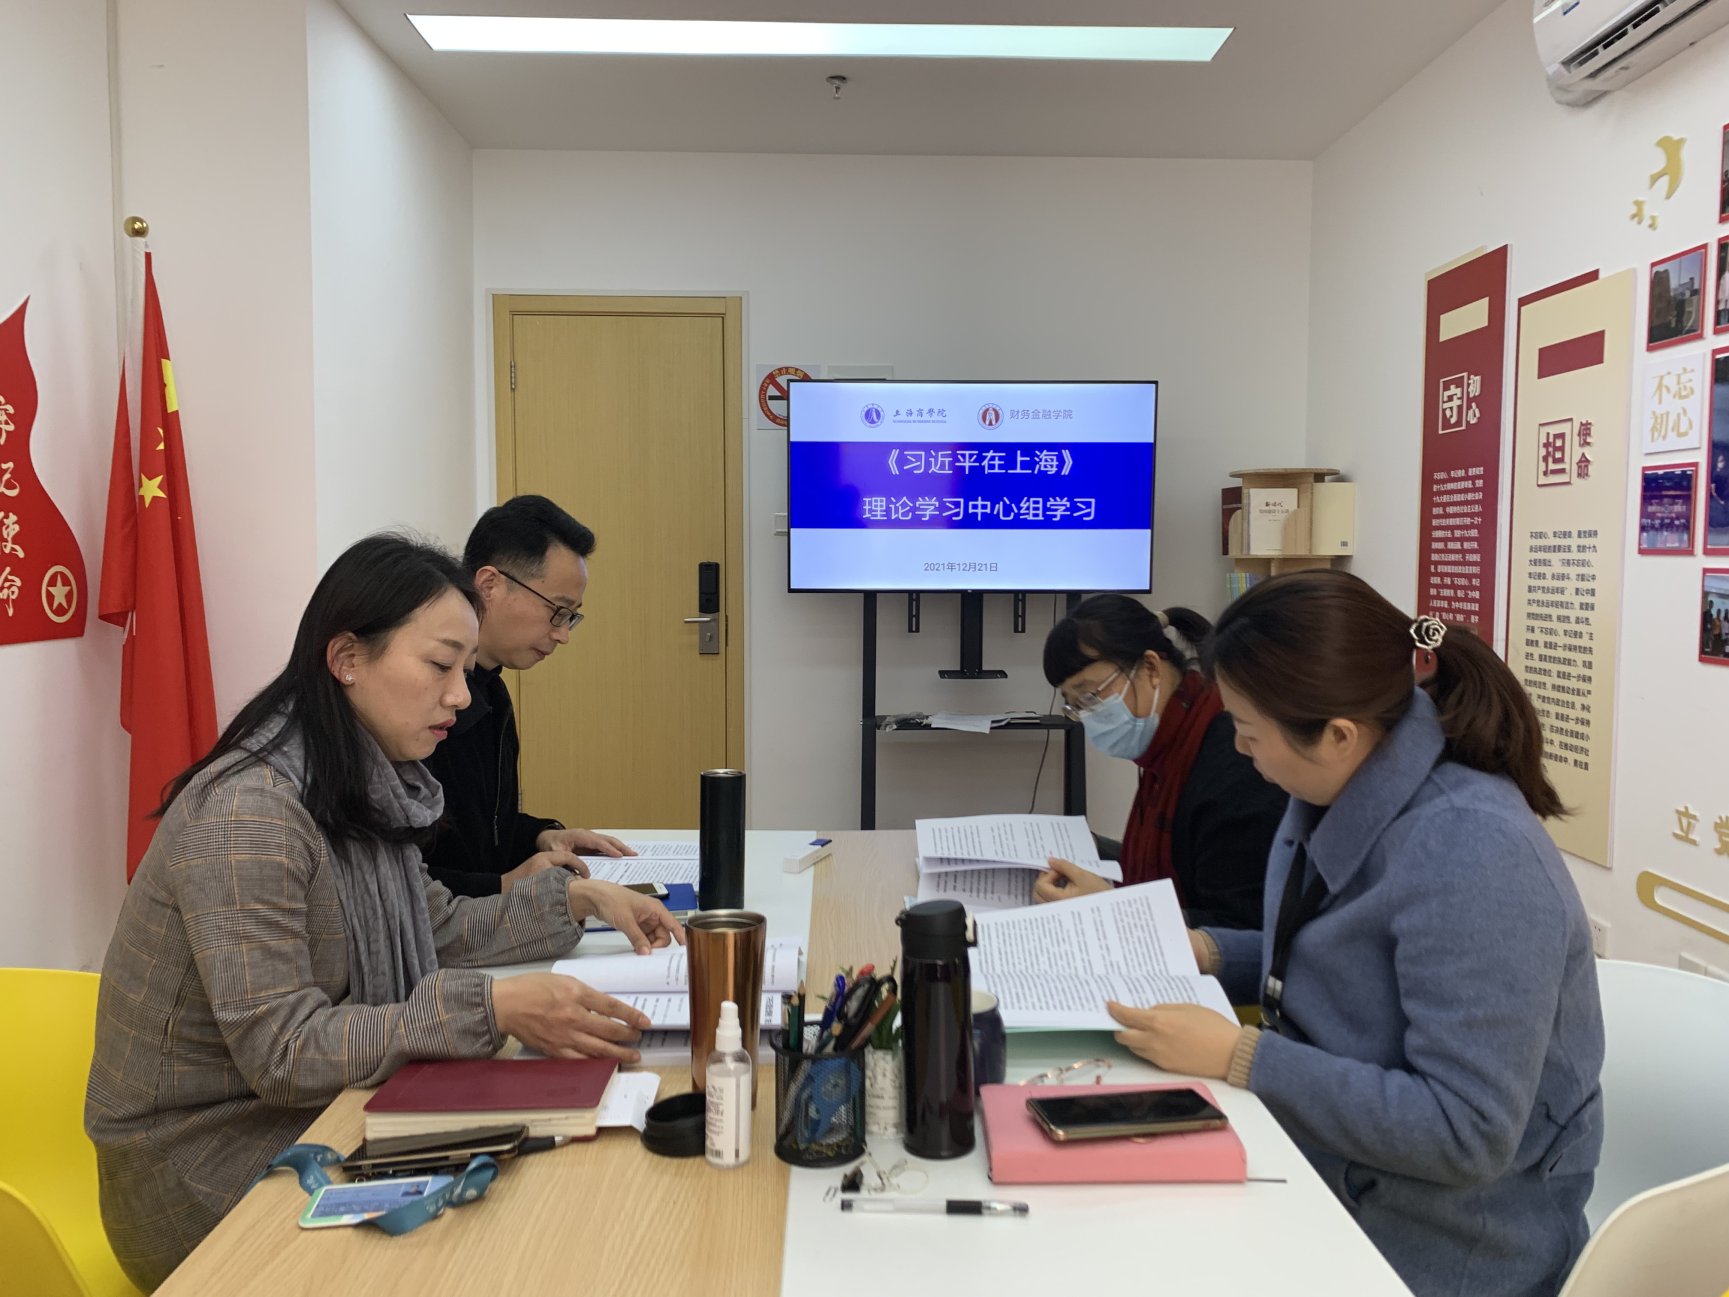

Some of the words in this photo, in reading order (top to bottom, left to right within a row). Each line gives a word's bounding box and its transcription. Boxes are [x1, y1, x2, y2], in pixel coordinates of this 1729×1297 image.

[1442, 383, 1463, 425] 守
[1467, 374, 1482, 425] 初心
[1651, 367, 1695, 405] 不忘
[1009, 408, 1073, 421] 财务金融学院
[1649, 407, 1694, 443] 初心
[887, 449, 1074, 475] 《习近平在上海》
[1542, 431, 1567, 478] 担
[1576, 420, 1593, 480] 使命
[862, 497, 1096, 521] 理论学习中心组学习
[923, 561, 998, 573] 2021年12月21日
